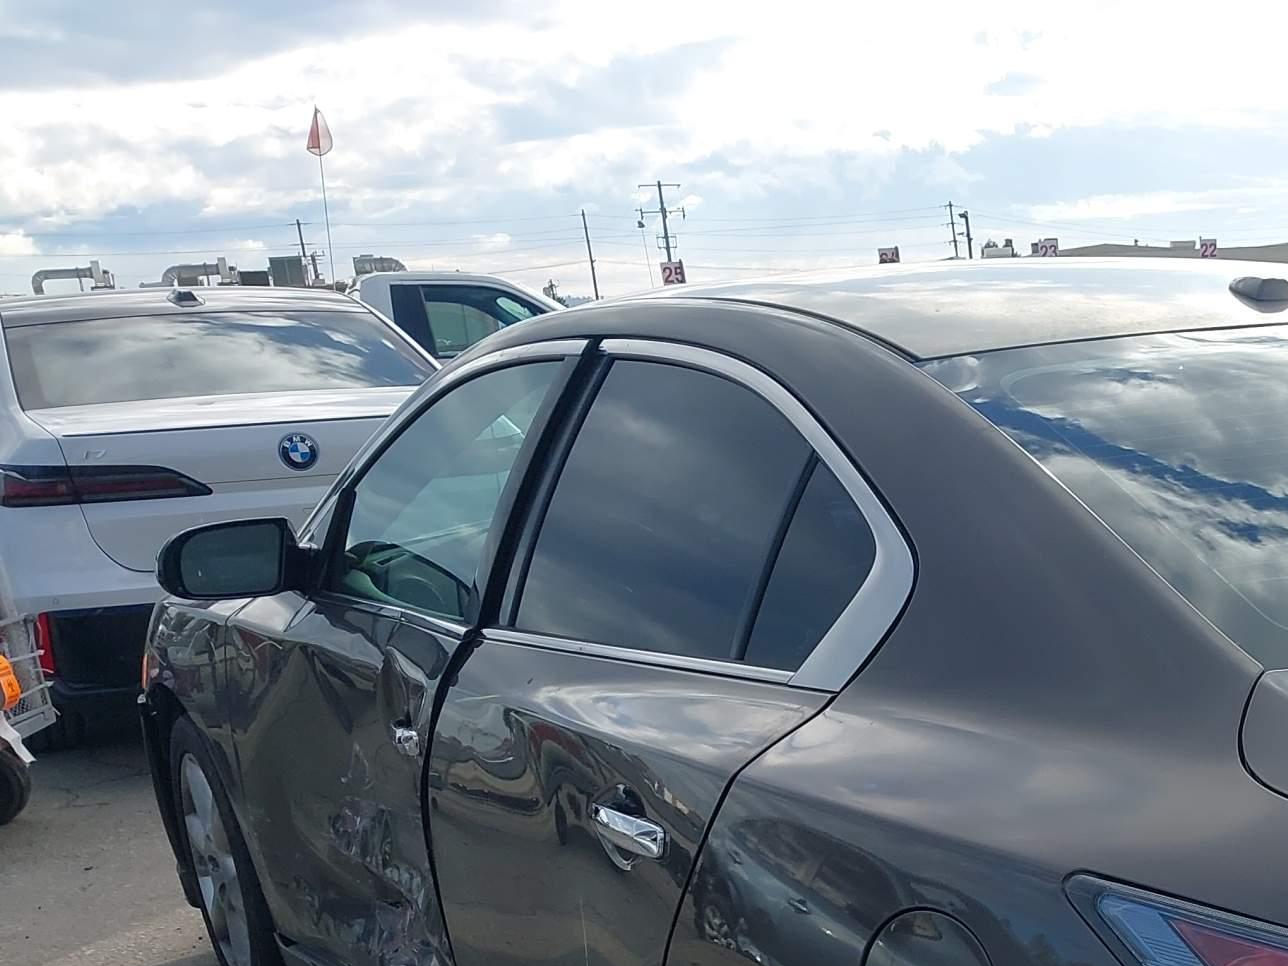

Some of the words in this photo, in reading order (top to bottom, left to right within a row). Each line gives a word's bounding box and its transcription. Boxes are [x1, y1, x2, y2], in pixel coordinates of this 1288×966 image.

[1040, 244, 1057, 257] 23
[1201, 243, 1216, 258] 22
[662, 266, 684, 284] 25
